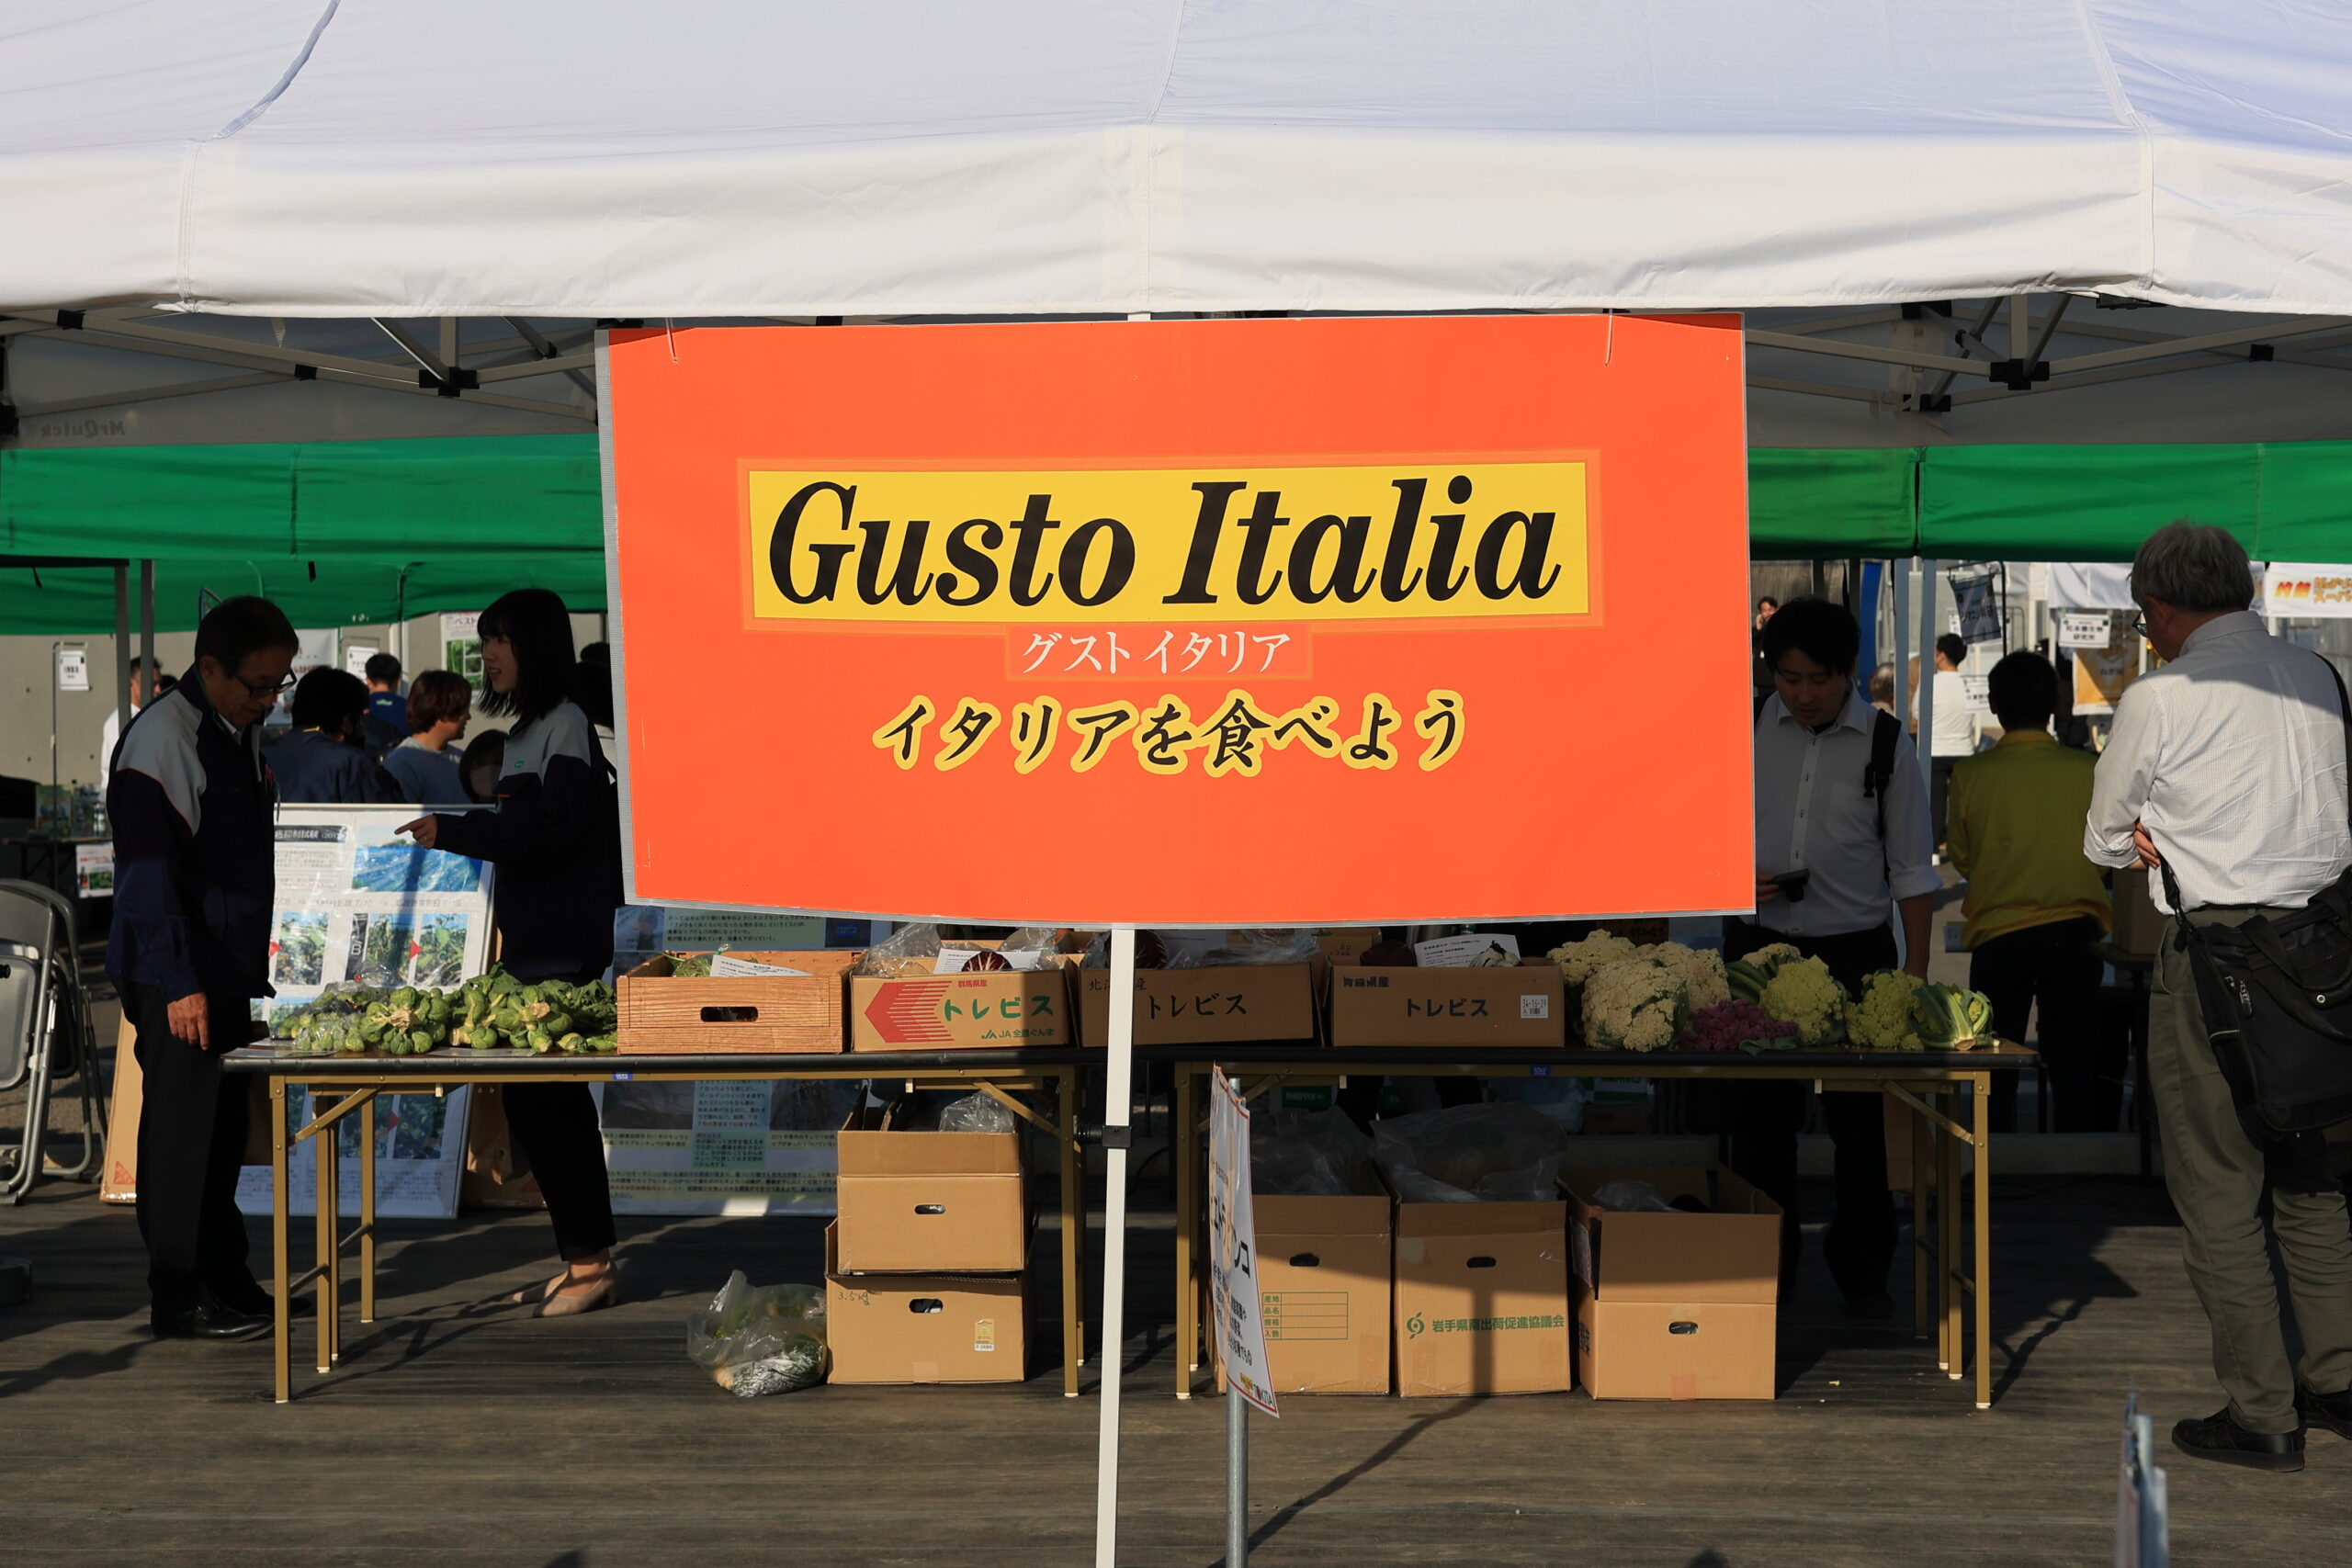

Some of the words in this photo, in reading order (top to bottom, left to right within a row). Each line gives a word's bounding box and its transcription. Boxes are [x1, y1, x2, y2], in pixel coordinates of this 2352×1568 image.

[769, 482, 1136, 606] Gusto
[1160, 475, 1562, 606] Italia
[1023, 631, 1131, 674] グスト
[1142, 630, 1292, 674] イタリア
[879, 694, 1461, 772] イタリアを食べよう
[957, 979, 989, 988] 群馬県産
[944, 995, 1054, 1022] トレビス
[1148, 992, 1248, 1020] トレビス
[1406, 998, 1489, 1018] トレビス
[998, 1030, 1012, 1039] JA
[1264, 1295, 1280, 1303] 産地
[1264, 1307, 1280, 1315] 品名
[1264, 1318, 1280, 1326] 規格
[1431, 1314, 1565, 1333] 岩手県南出荷促進協議会
